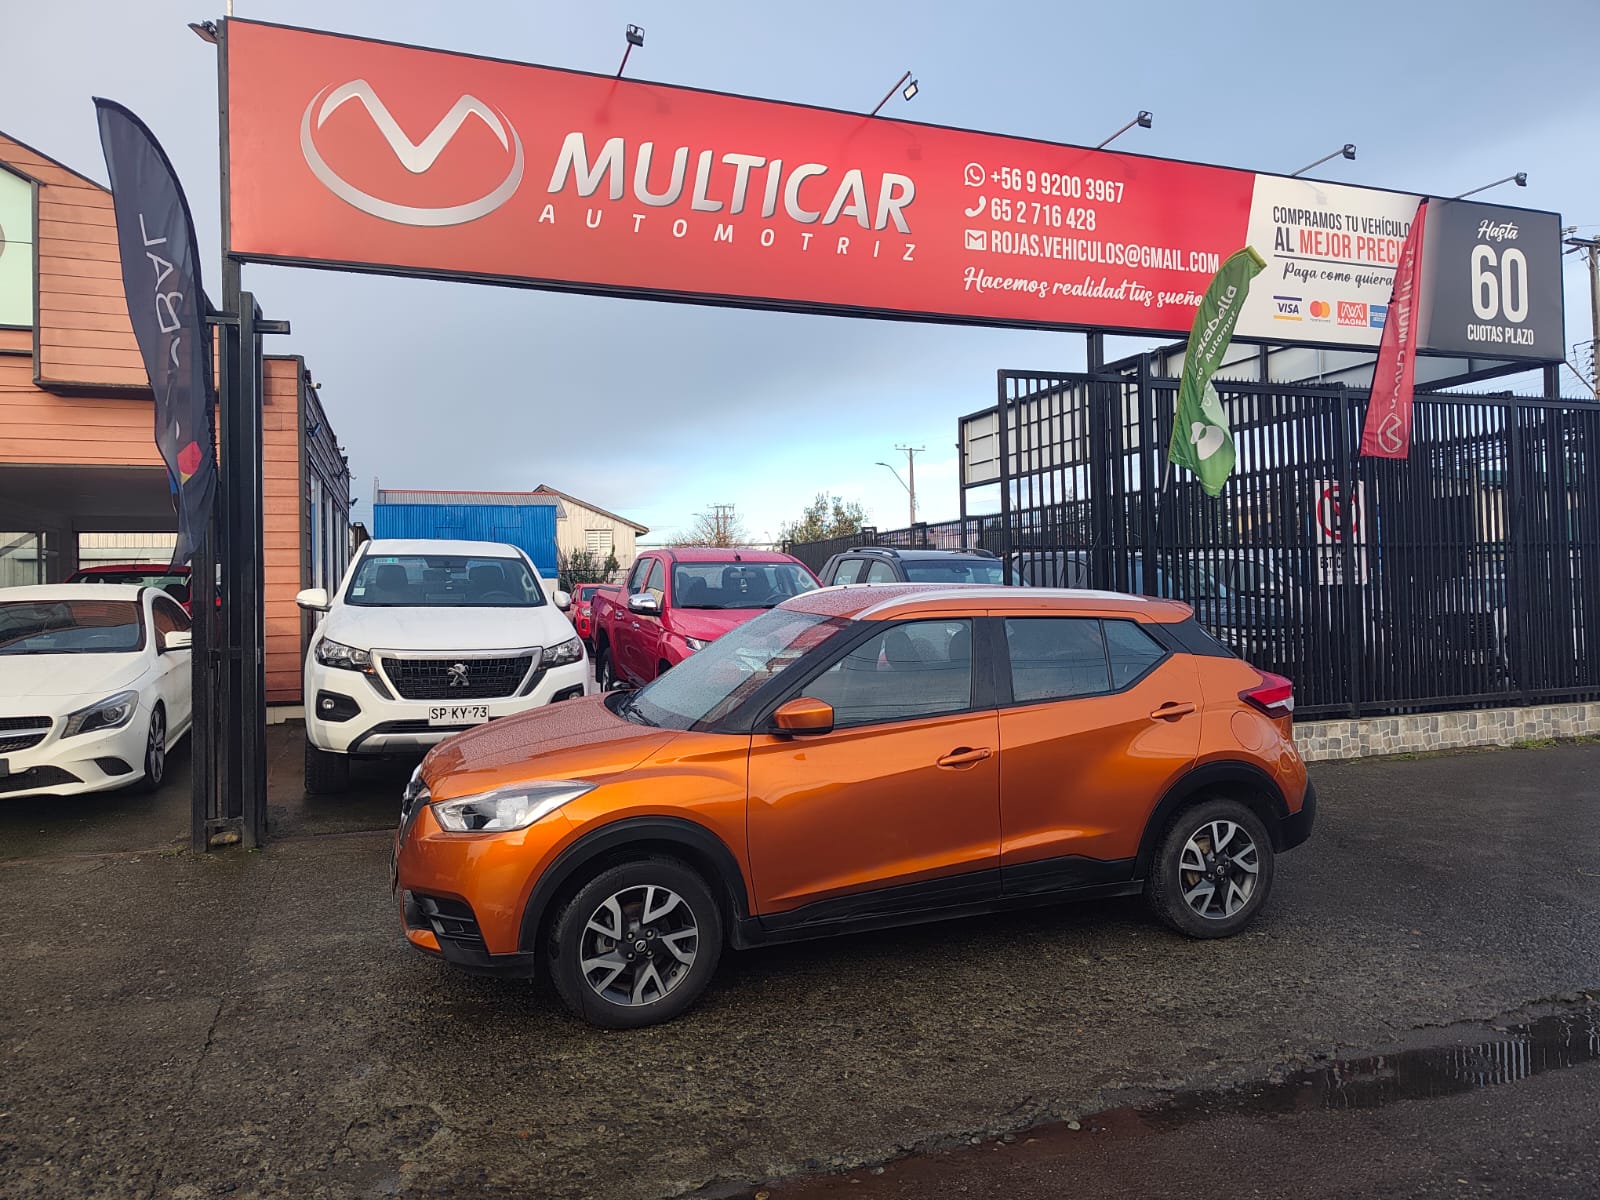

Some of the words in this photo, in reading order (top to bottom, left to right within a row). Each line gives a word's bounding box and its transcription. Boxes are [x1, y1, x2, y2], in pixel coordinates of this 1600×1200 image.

[548, 132, 916, 234] MULTICAR
[990, 166, 1022, 191] +56
[1026, 170, 1036, 192] 9
[1041, 173, 1081, 198] 9200
[1085, 179, 1124, 203] 3967
[539, 203, 917, 262] AUTOMOTRIZ
[991, 198, 1012, 222] 65
[1016, 201, 1026, 224] 2
[1031, 203, 1062, 228] 716
[1066, 208, 1096, 231] 428
[1272, 206, 1342, 232] COMPRAMOS
[1345, 215, 1358, 233] TU
[1361, 216, 1411, 238] VEHÍCULO
[1478, 219, 1519, 242] Hasta
[991, 230, 1219, 274] ROJAS.VEHICULOS@GMAIL.COM
[1274, 227, 1294, 253] AL
[1300, 231, 1351, 259] MEJOR
[1357, 236, 1406, 264] PRECI
[963, 266, 1049, 298] Hacemos
[1052, 276, 1126, 301] realidad
[1124, 281, 1153, 308] tus
[1157, 290, 1203, 308] sueño
[1283, 262, 1317, 280] Paga
[1320, 268, 1352, 284] como
[1355, 270, 1395, 288] quiera
[1471, 244, 1529, 324] 60
[1278, 303, 1299, 314] VISA
[1467, 324, 1503, 343] CUOTAS
[1504, 327, 1534, 346] PLAZO
